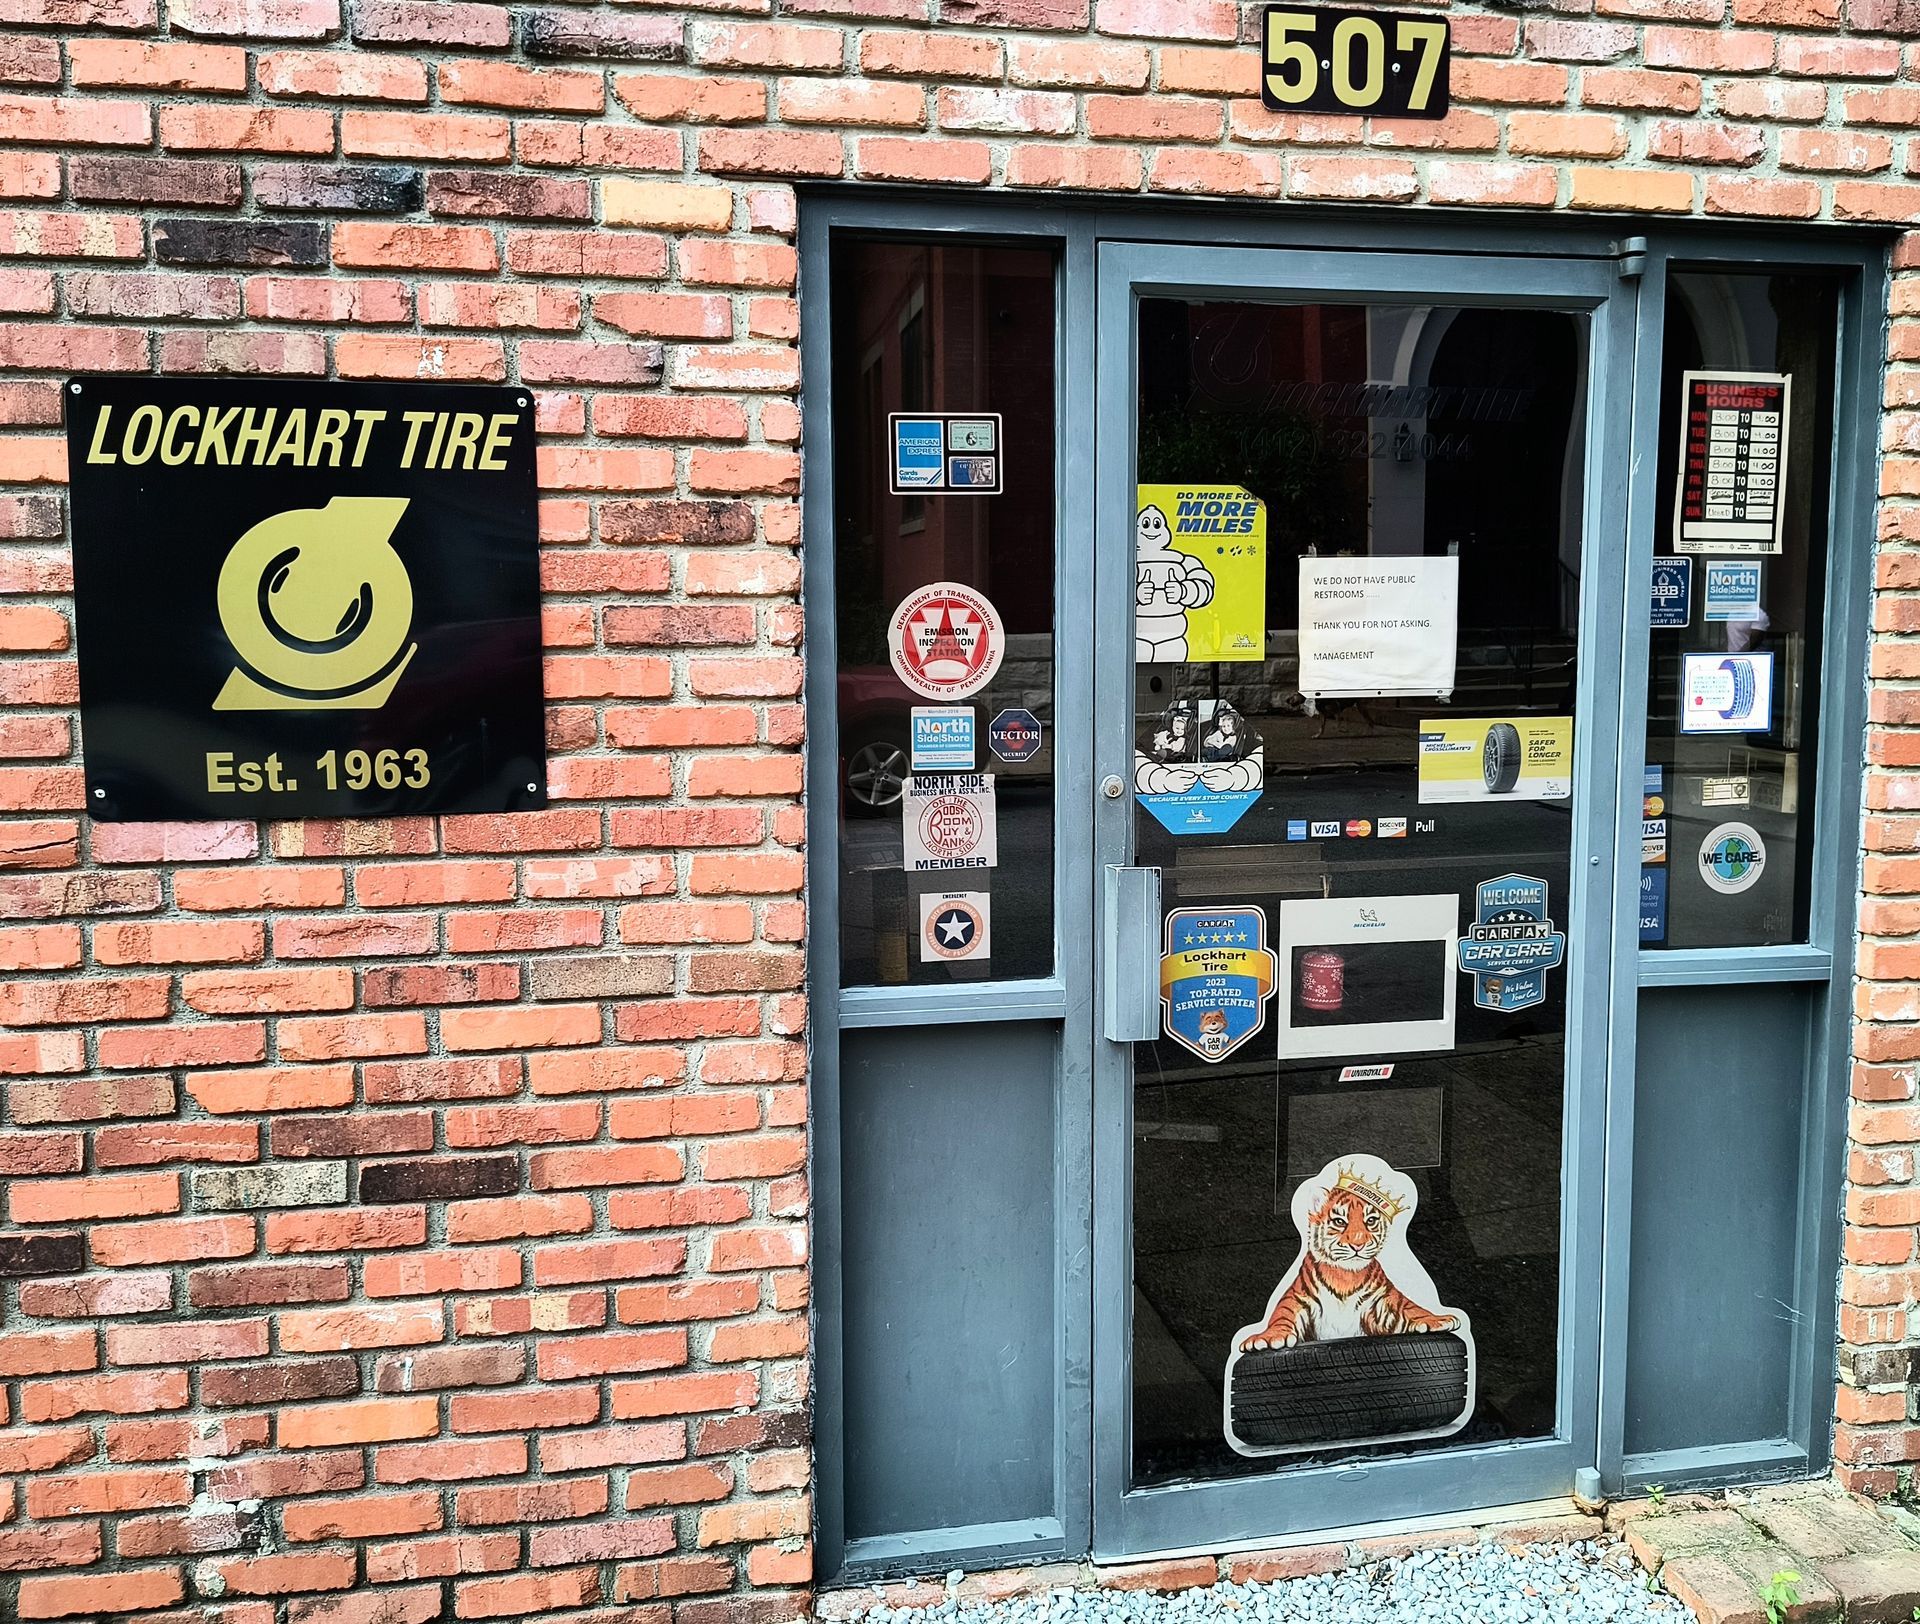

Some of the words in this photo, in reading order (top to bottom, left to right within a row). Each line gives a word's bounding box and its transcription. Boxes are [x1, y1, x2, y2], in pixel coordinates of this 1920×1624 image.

[1266, 12, 1446, 110] 507
[1695, 384, 1778, 397] BUSINESS
[1264, 382, 1454, 418] LOCKHART
[1456, 385, 1536, 420] TIRE
[1707, 396, 1765, 408] HOURS
[1740, 413, 1750, 423] TO
[86, 404, 387, 468] LOCKHART
[400, 412, 519, 471] TIRE
[1739, 429, 1749, 439] TO
[899, 438, 939, 446] AMERICAN
[907, 447, 942, 455] EXPRESS
[1738, 444, 1748, 455] TO
[1737, 460, 1747, 471] TO
[1736, 476, 1746, 486] TO
[1176, 492, 1194, 500] DO
[1735, 492, 1745, 502] TO
[1176, 501, 1259, 516] MORE
[1734, 507, 1744, 517] TO
[1176, 518, 1254, 533] MILES
[1314, 577, 1328, 585] WE
[1330, 577, 1342, 585] DO
[1363, 576, 1386, 584] HAVE
[1387, 575, 1415, 583] PUBLIC
[1711, 571, 1756, 585] North
[1314, 590, 1364, 599] RESTROOMS
[896, 593, 931, 630] DEPARTMENT
[946, 590, 995, 631] TRANSPORTATION
[1313, 622, 1340, 630] THANK
[1343, 621, 1360, 629] YOU
[1362, 621, 1378, 629] FOR
[1380, 620, 1398, 628] NOT
[1400, 620, 1431, 628] ASKING.
[924, 628, 969, 636] EMISSION
[919, 638, 974, 646] INSPECTION
[926, 648, 967, 657] STATION
[1313, 651, 1374, 660] MANAGEMENT
[895, 650, 942, 693] COMMONWEALTH
[960, 649, 996, 691] PENNSYLVANIA
[917, 718, 970, 733] North
[992, 730, 1039, 740] VECTOR
[205, 752, 298, 793] Est.
[316, 748, 431, 791] 1963
[914, 776, 954, 789] NORTH
[960, 774, 985, 787] SIDE
[932, 798, 946, 808] ON
[954, 797, 967, 808] THE
[1314, 824, 1339, 834] VISA
[1416, 820, 1435, 832] Pull
[926, 841, 952, 856] NORTH
[959, 840, 974, 855] SIDE
[915, 857, 987, 870] MEMBER
[1703, 853, 1723, 864] WE
[1483, 888, 1542, 906] WELCOME
[1197, 919, 1235, 928] CARFAX
[1639, 917, 1659, 928] ISA
[1475, 925, 1548, 941] CARFAX
[1465, 944, 1504, 960] CAR
[1505, 942, 1555, 958] CARE
[1184, 951, 1247, 963] Lockhart
[1202, 963, 1228, 972] Tire
[1206, 978, 1226, 987] 2023
[1189, 988, 1242, 999] TOP-RATED
[1175, 999, 1216, 1012] SERVICE
[1218, 997, 1256, 1009] CENTER
[1350, 1068, 1382, 1077] UNIROYAL
[1353, 1184, 1384, 1206] UNIROYAL
